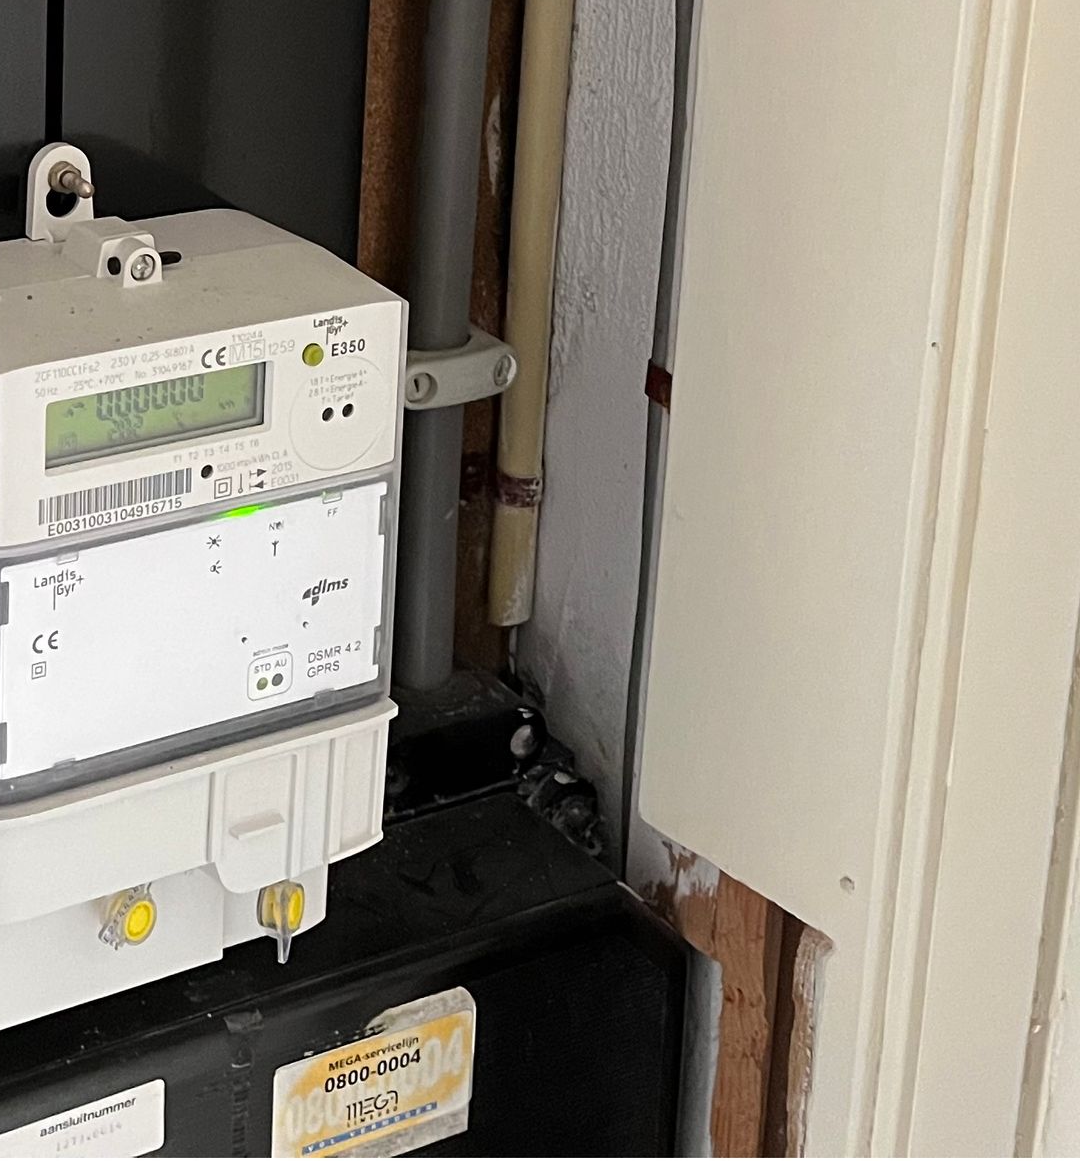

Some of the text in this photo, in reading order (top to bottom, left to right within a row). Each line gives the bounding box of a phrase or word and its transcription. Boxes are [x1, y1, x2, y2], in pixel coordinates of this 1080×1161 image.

[269, 339, 296, 356] 1259
[331, 338, 366, 357] E350
[189, 451, 198, 460] T2
[204, 448, 214, 457] T3
[220, 445, 229, 453] T4
[235, 442, 244, 451] T5
[47, 496, 183, 537] E0031003104916715
[57, 583, 76, 597] Gyr
[311, 577, 349, 596] dlms
[307, 645, 342, 664] DSMR
[254, 662, 272, 674] STD
[306, 660, 340, 678] GPRS
[328, 1036, 419, 1072] MEGA-servicelijn
[324, 1049, 421, 1093] 0800-0004
[40, 1097, 136, 1137] aansluitnummer
